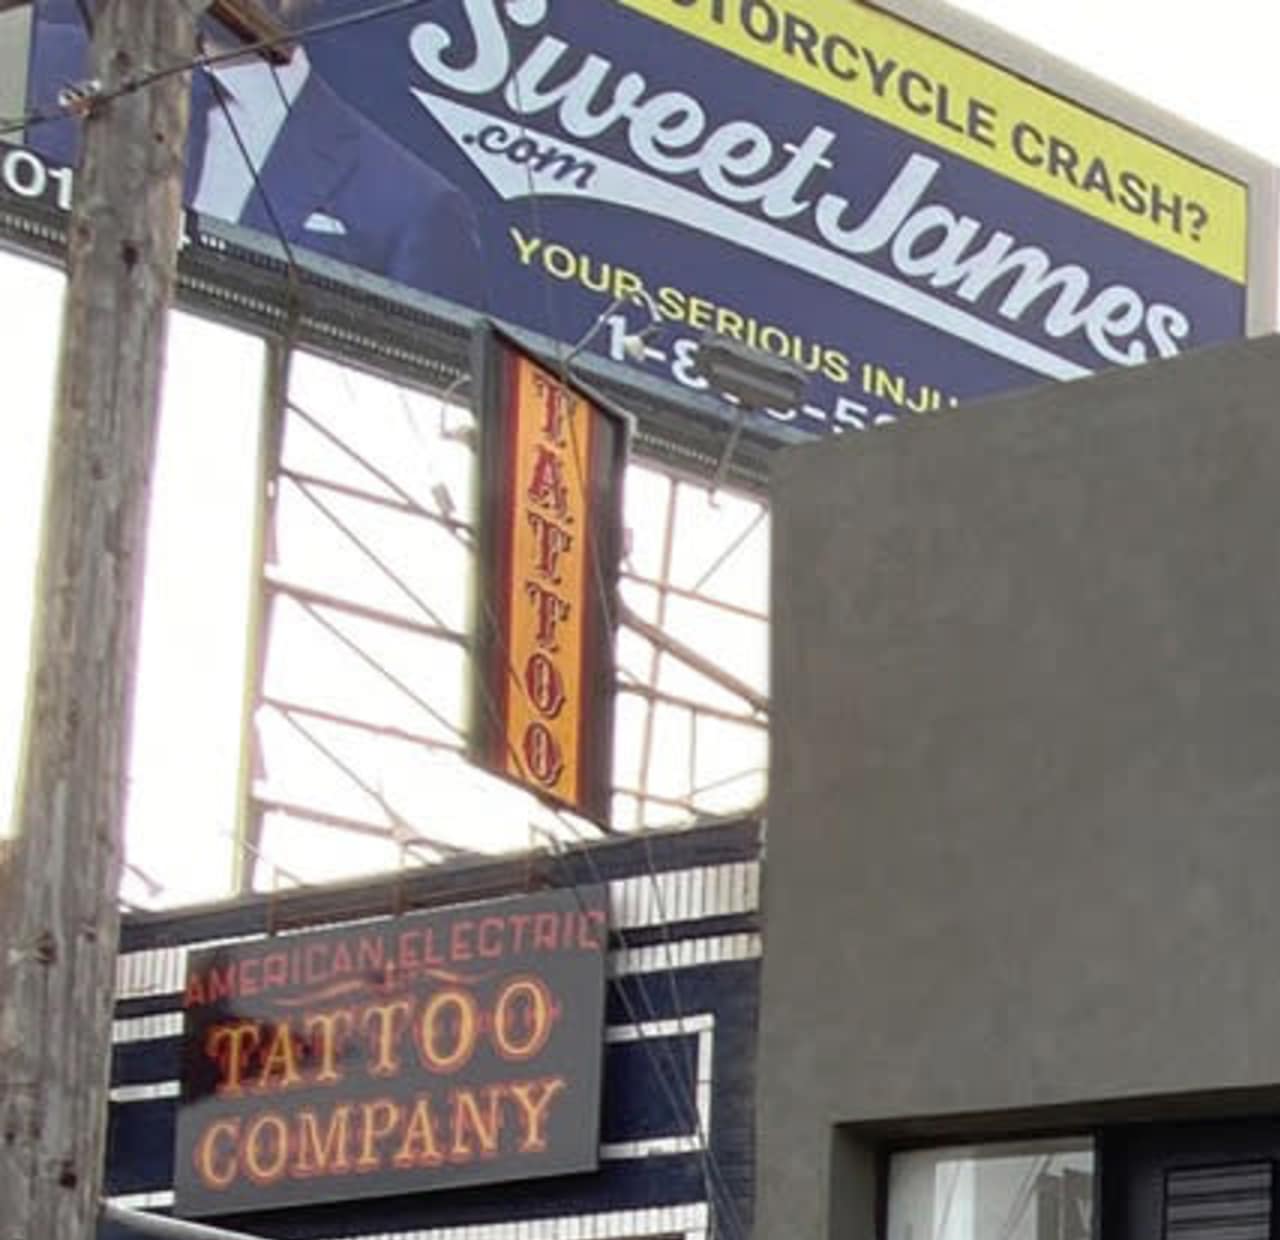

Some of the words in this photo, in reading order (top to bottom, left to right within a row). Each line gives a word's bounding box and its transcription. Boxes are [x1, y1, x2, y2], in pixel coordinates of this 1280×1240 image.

[409, 0, 836, 218] Sweet
[815, 152, 1191, 368] James
[461, 125, 596, 189] .com
[1011, 122, 1209, 243] CRASH?
[509, 227, 644, 306] YOUR
[657, 286, 850, 384] SERIOUS
[522, 373, 576, 788] TATTOO
[183, 936, 386, 1008] AMERICAN
[400, 910, 607, 968] ELECTRIC
[208, 978, 557, 1094] TATTOO
[197, 1078, 567, 1188] COMPANY
